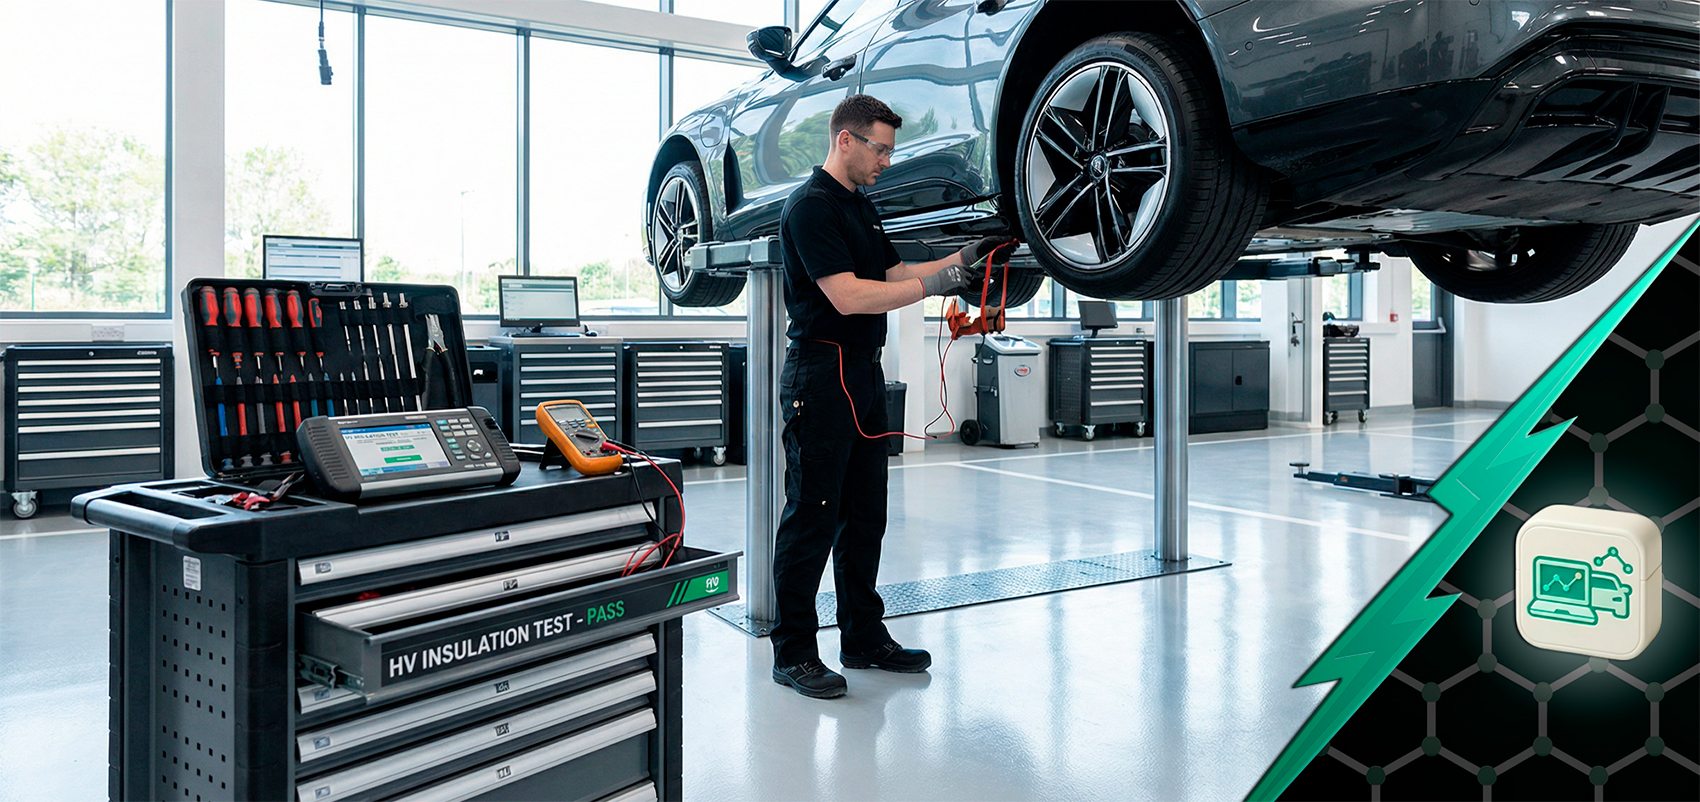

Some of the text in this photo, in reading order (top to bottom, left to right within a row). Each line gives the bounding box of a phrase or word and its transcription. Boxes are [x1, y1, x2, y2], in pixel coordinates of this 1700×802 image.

[389, 652, 418, 678] HV
[422, 624, 530, 670] INSULATION
[533, 612, 574, 639] TEST
[587, 600, 625, 625] PASS
